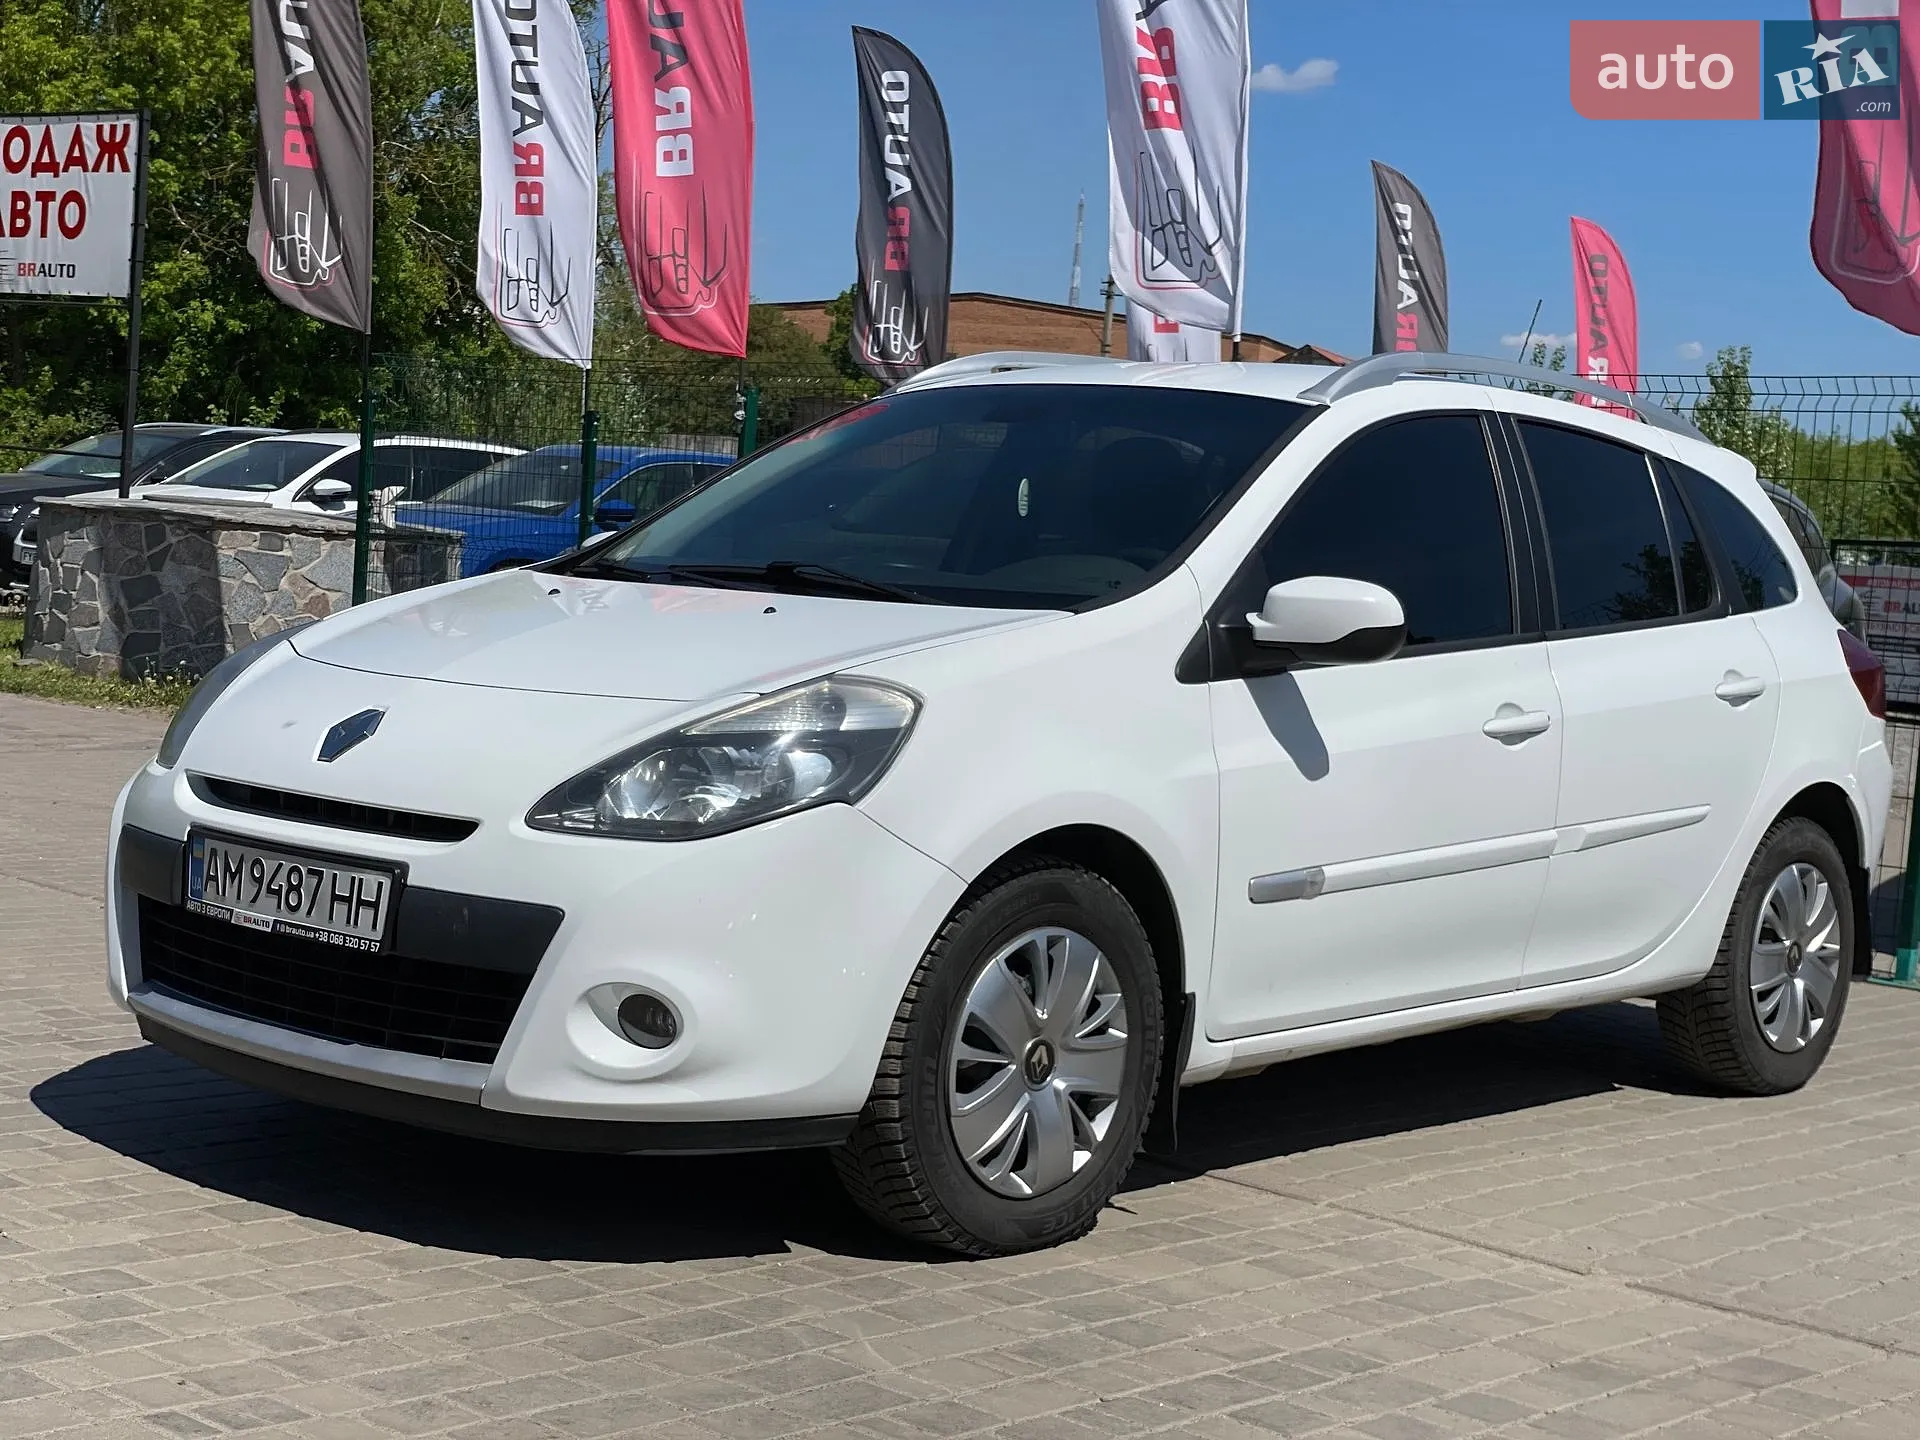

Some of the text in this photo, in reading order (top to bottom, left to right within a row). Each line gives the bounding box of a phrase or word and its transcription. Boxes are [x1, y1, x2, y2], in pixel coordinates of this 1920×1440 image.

[0, 189, 87, 240] ВТО
[17, 262, 76, 279] BRAUTO
[243, 915, 270, 929] BRAUTO
[315, 931, 328, 942] +38
[329, 933, 344, 946] 068
[345, 936, 359, 949] 320
[360, 939, 370, 951] 57
[370, 942, 380, 953] 57
